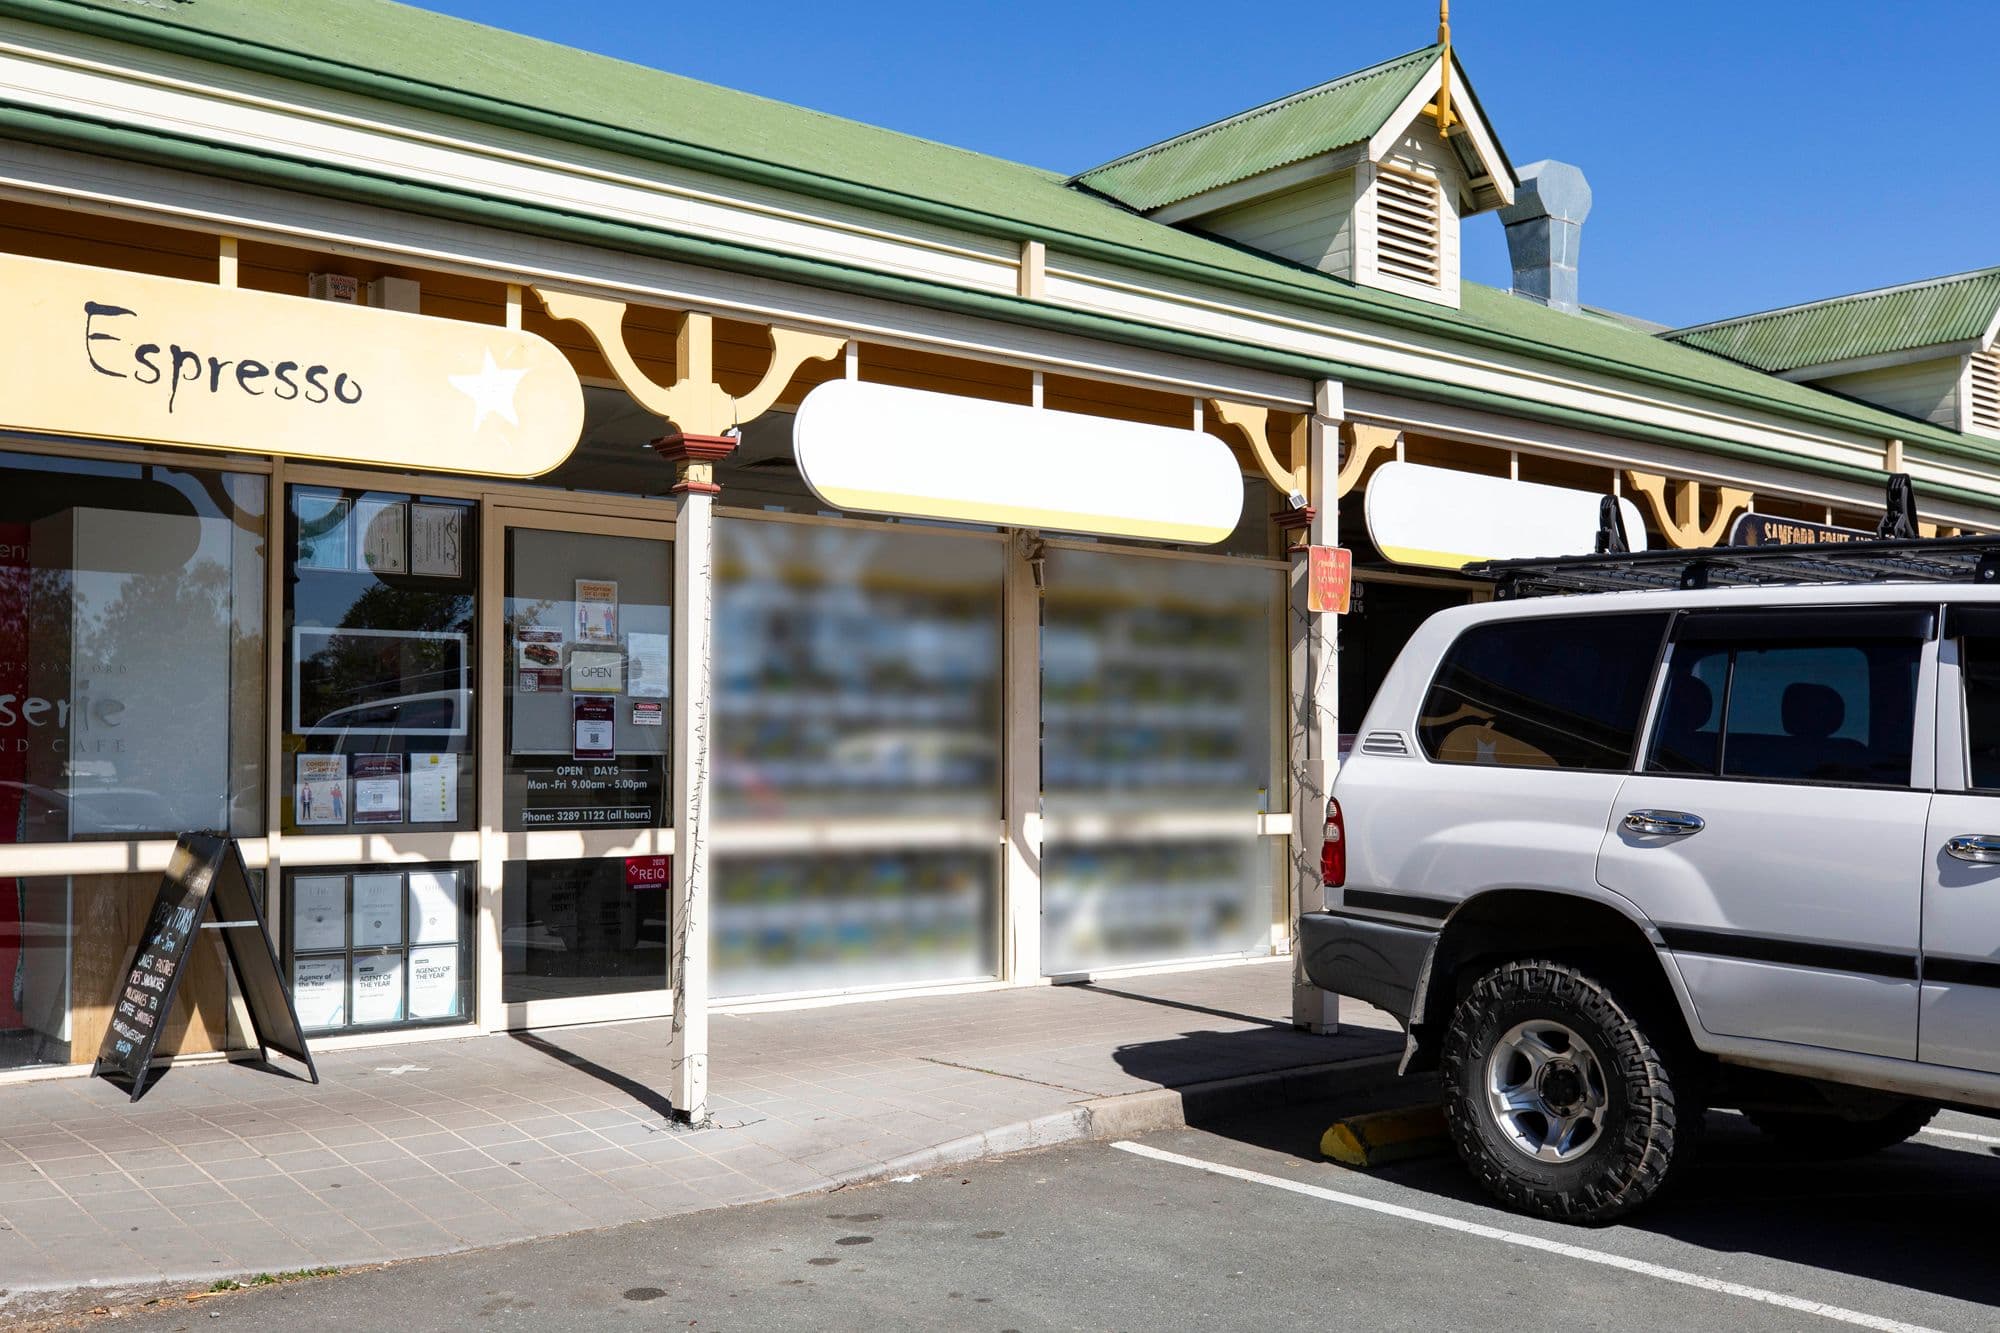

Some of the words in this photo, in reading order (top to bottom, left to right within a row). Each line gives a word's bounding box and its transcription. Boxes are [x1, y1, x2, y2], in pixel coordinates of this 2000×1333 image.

[84, 301, 362, 413] Espresso
[581, 666, 612, 678] OPEN
[556, 766, 583, 775] OPEN
[593, 766, 619, 775] DAYS
[527, 780, 548, 790] Mon
[571, 779, 606, 789] 9.00am
[614, 779, 648, 791] 5.00pm
[521, 811, 554, 822] Phone:
[557, 811, 580, 821] 3289
[583, 811, 605, 820] 1122
[607, 810, 622, 821] (all
[624, 809, 651, 820] hours)
[639, 868, 666, 880] REIQ
[298, 974, 323, 982] Agency
